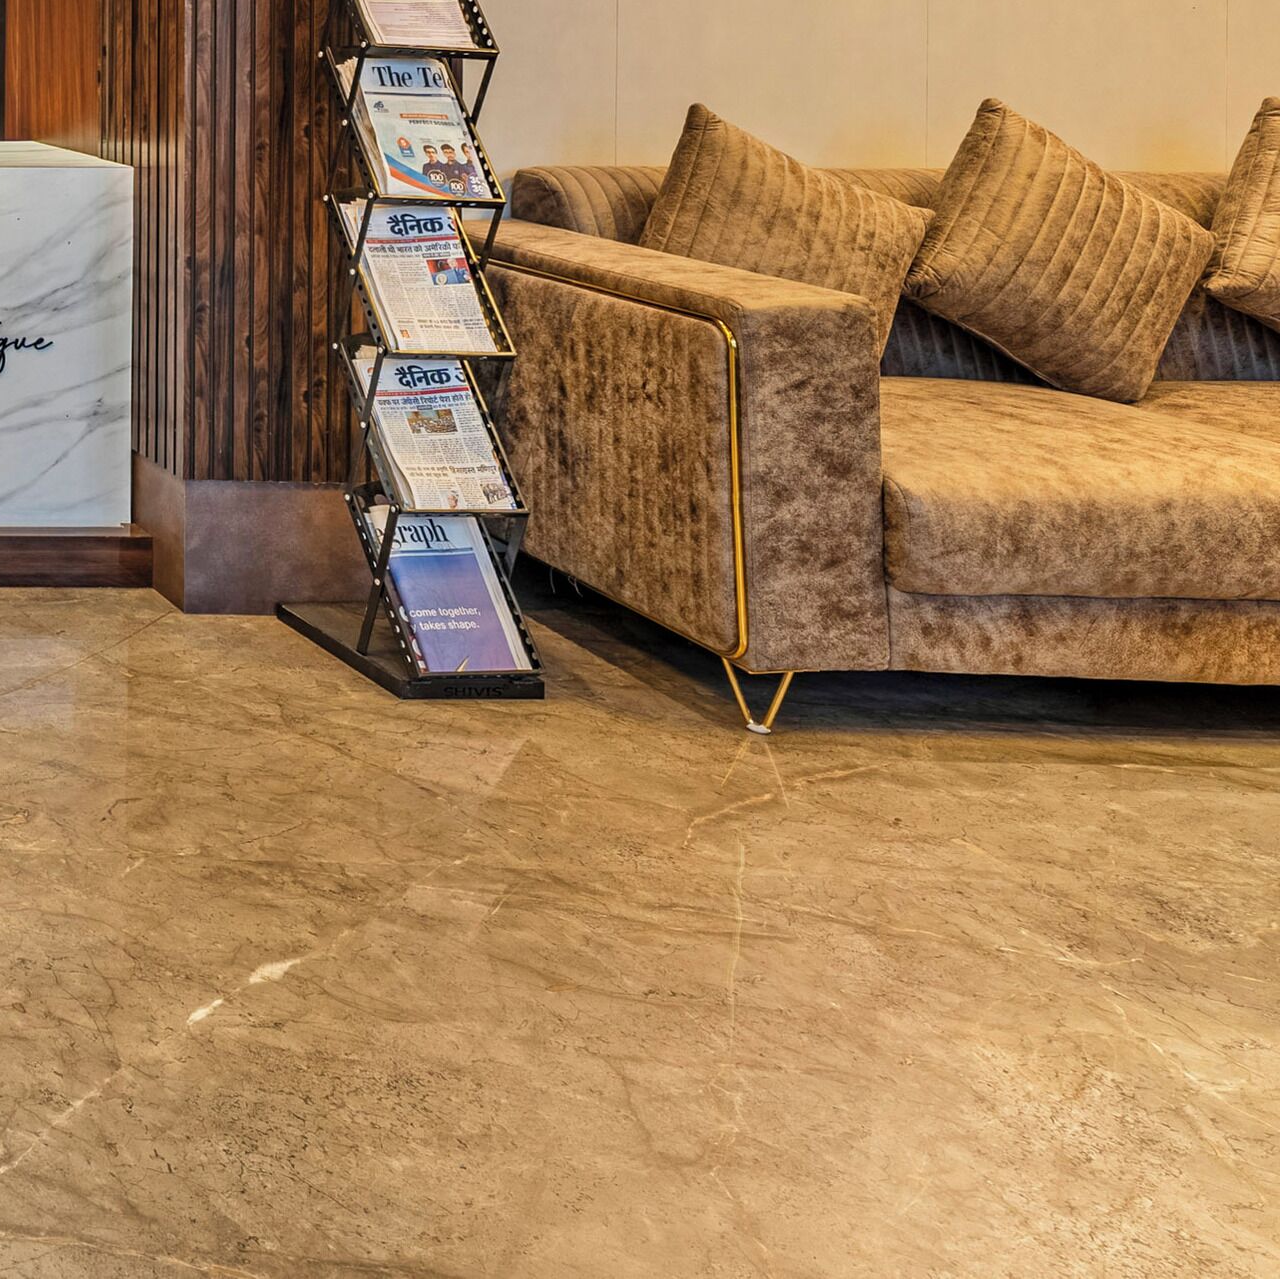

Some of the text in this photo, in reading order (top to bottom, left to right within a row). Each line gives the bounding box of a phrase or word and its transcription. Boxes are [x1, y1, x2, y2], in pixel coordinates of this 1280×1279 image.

[372, 65, 413, 88] The
[386, 213, 444, 237] दैनिक
[394, 364, 452, 389] दैनिक
[409, 606, 482, 618] come together,
[419, 621, 447, 631] takes
[447, 620, 481, 631] shape.
